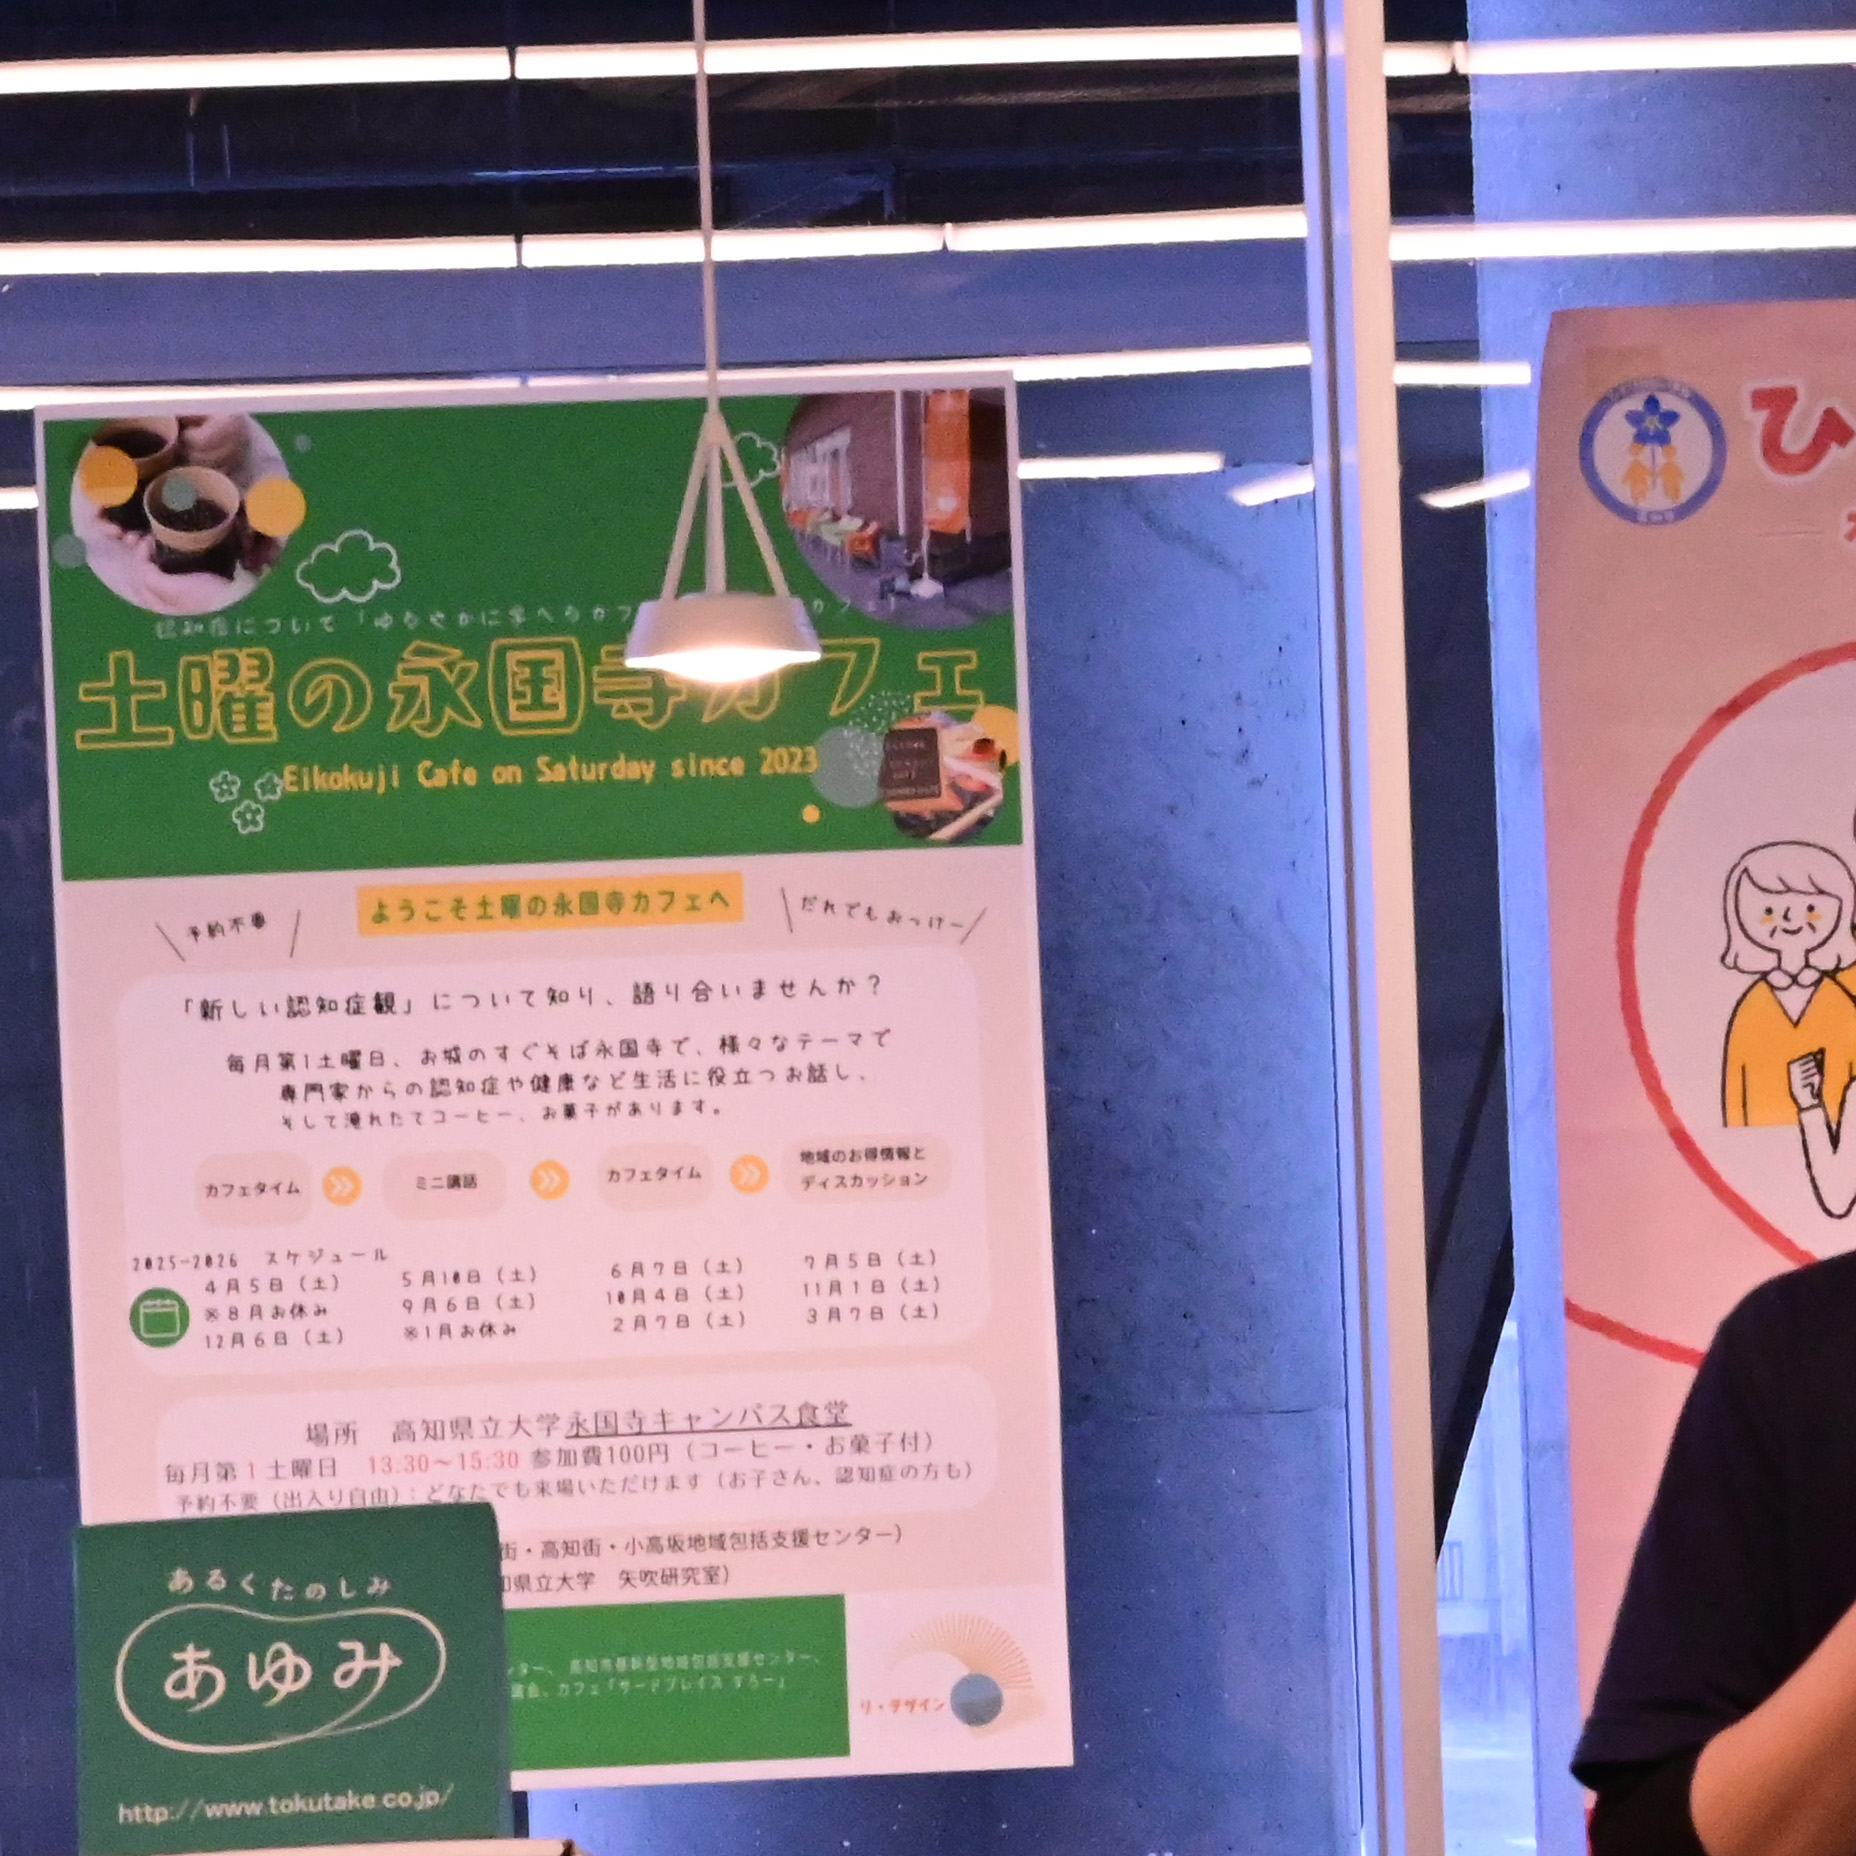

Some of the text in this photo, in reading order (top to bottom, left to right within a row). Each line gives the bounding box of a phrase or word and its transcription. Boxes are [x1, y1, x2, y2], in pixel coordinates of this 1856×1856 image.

[282, 746, 820, 795] Eikokuji Cafe on Saturday since 2023
[370, 889, 731, 925] ようこそ土曜の永国寺カフェへ
[607, 1165, 703, 1183] カフェタイム
[800, 1172, 929, 1192] ディスカッション
[204, 1180, 301, 1198] カフェタイム
[266, 1248, 389, 1267] スケジュール
[305, 1419, 360, 1447] 場所
[166, 1567, 392, 1602] あるくたのしみ
[163, 1640, 404, 1712] あゆみ
